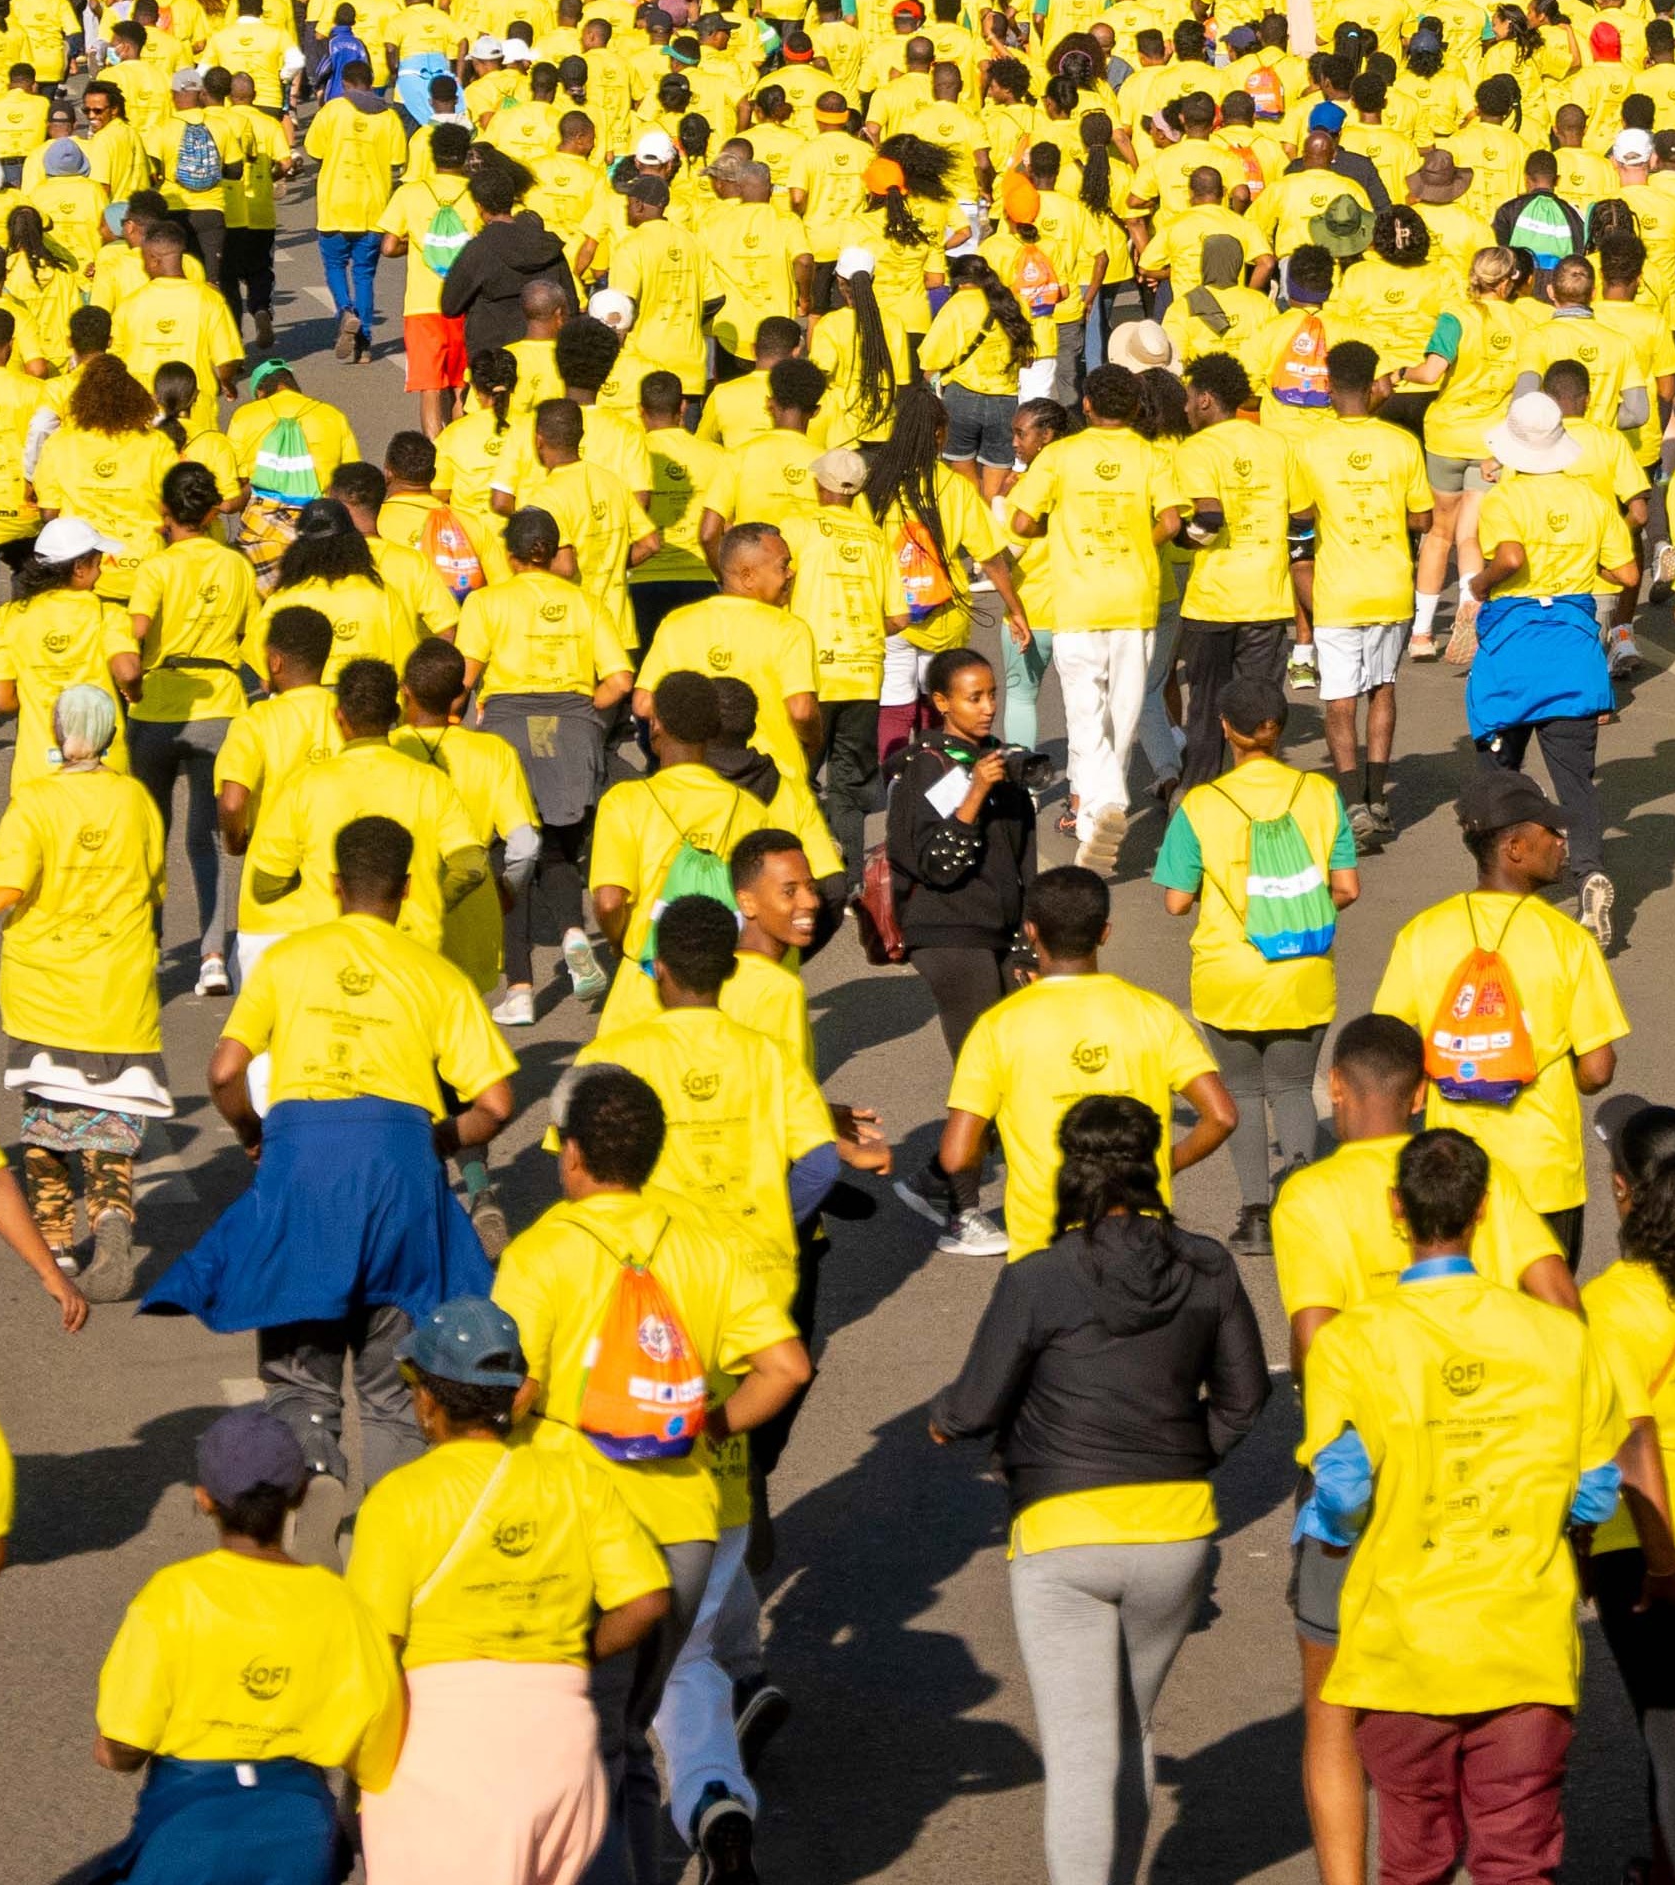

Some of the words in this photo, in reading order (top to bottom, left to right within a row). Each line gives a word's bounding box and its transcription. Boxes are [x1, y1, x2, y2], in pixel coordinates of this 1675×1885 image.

[103, 553, 141, 569] ACO
[540, 604, 567, 617] SOFI
[42, 635, 70, 648] SOFI
[819, 650, 835, 665] 24
[78, 829, 108, 845] SOFI
[336, 973, 375, 987] SOFI
[1071, 1045, 1109, 1065] SOFI
[682, 1073, 720, 1093] SOFI
[1441, 1361, 1485, 1385] SOFI
[492, 1521, 538, 1547] SOFI
[238, 1666, 291, 1686] SOFI
